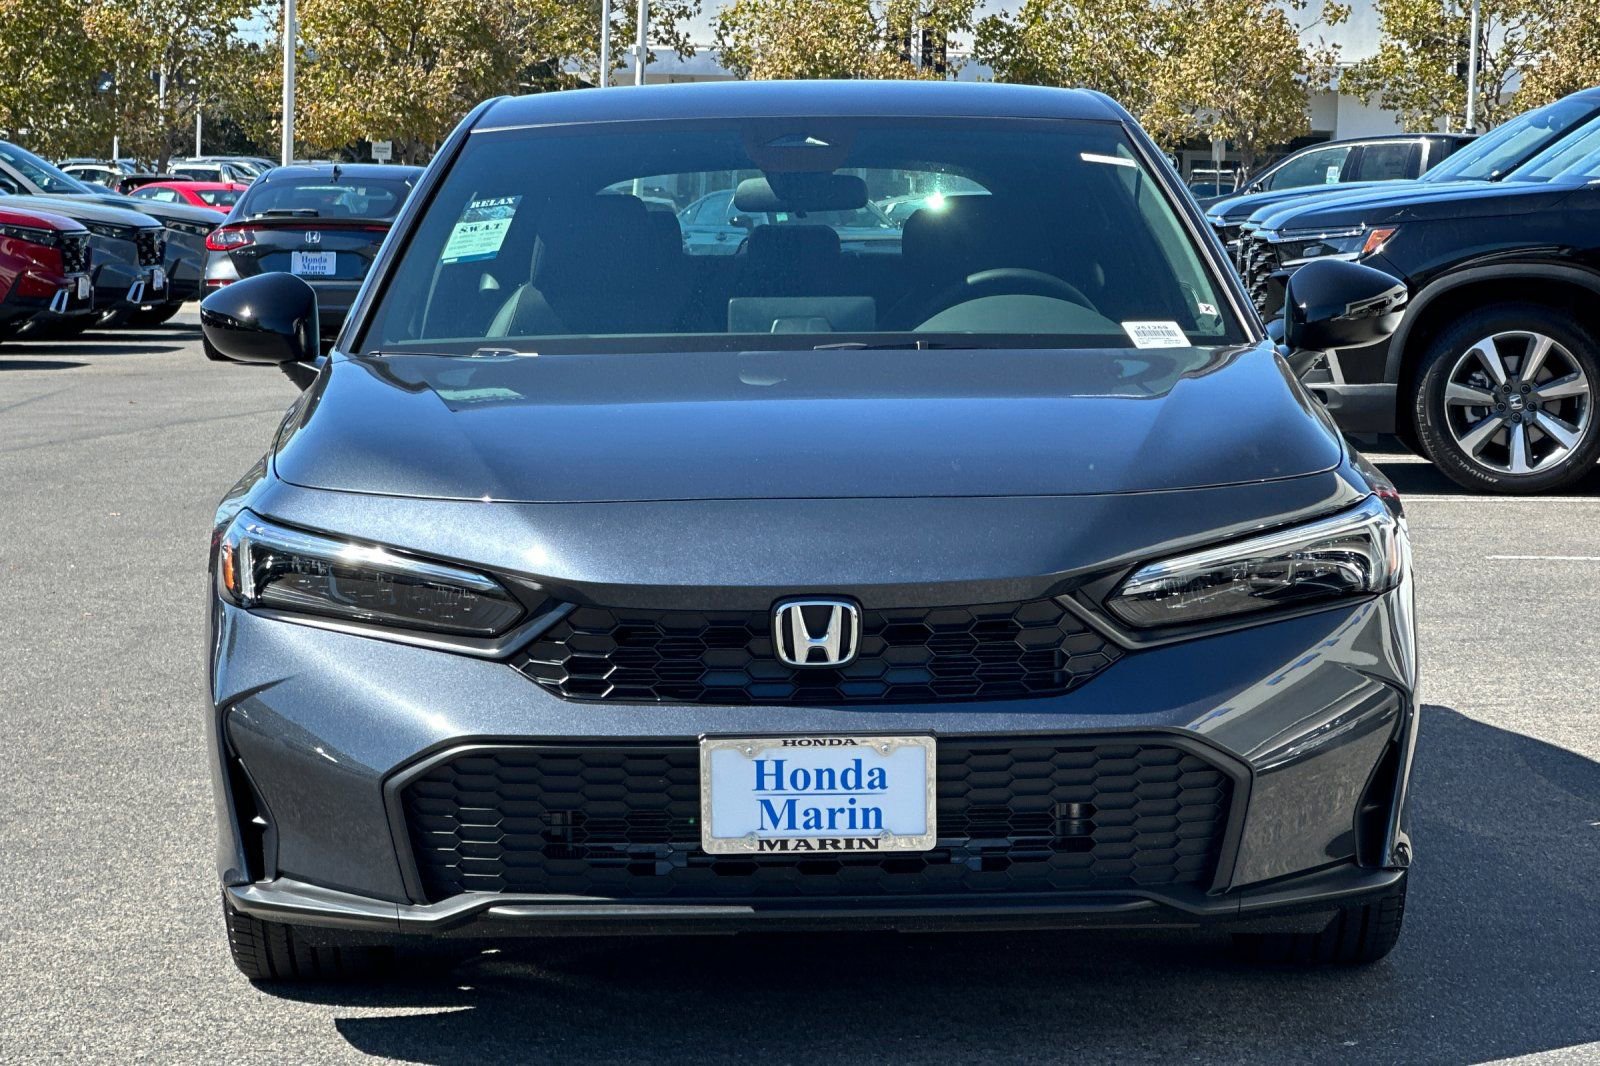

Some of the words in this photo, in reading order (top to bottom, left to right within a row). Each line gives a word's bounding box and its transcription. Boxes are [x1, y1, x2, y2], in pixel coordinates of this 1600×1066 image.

[469, 197, 516, 209] RELAX
[301, 255, 328, 264] Honda
[302, 263, 327, 271] Marin
[781, 738, 859, 747] HONDA
[751, 758, 889, 792] Honda
[756, 797, 886, 831] Marin
[757, 837, 882, 852] MARIN
